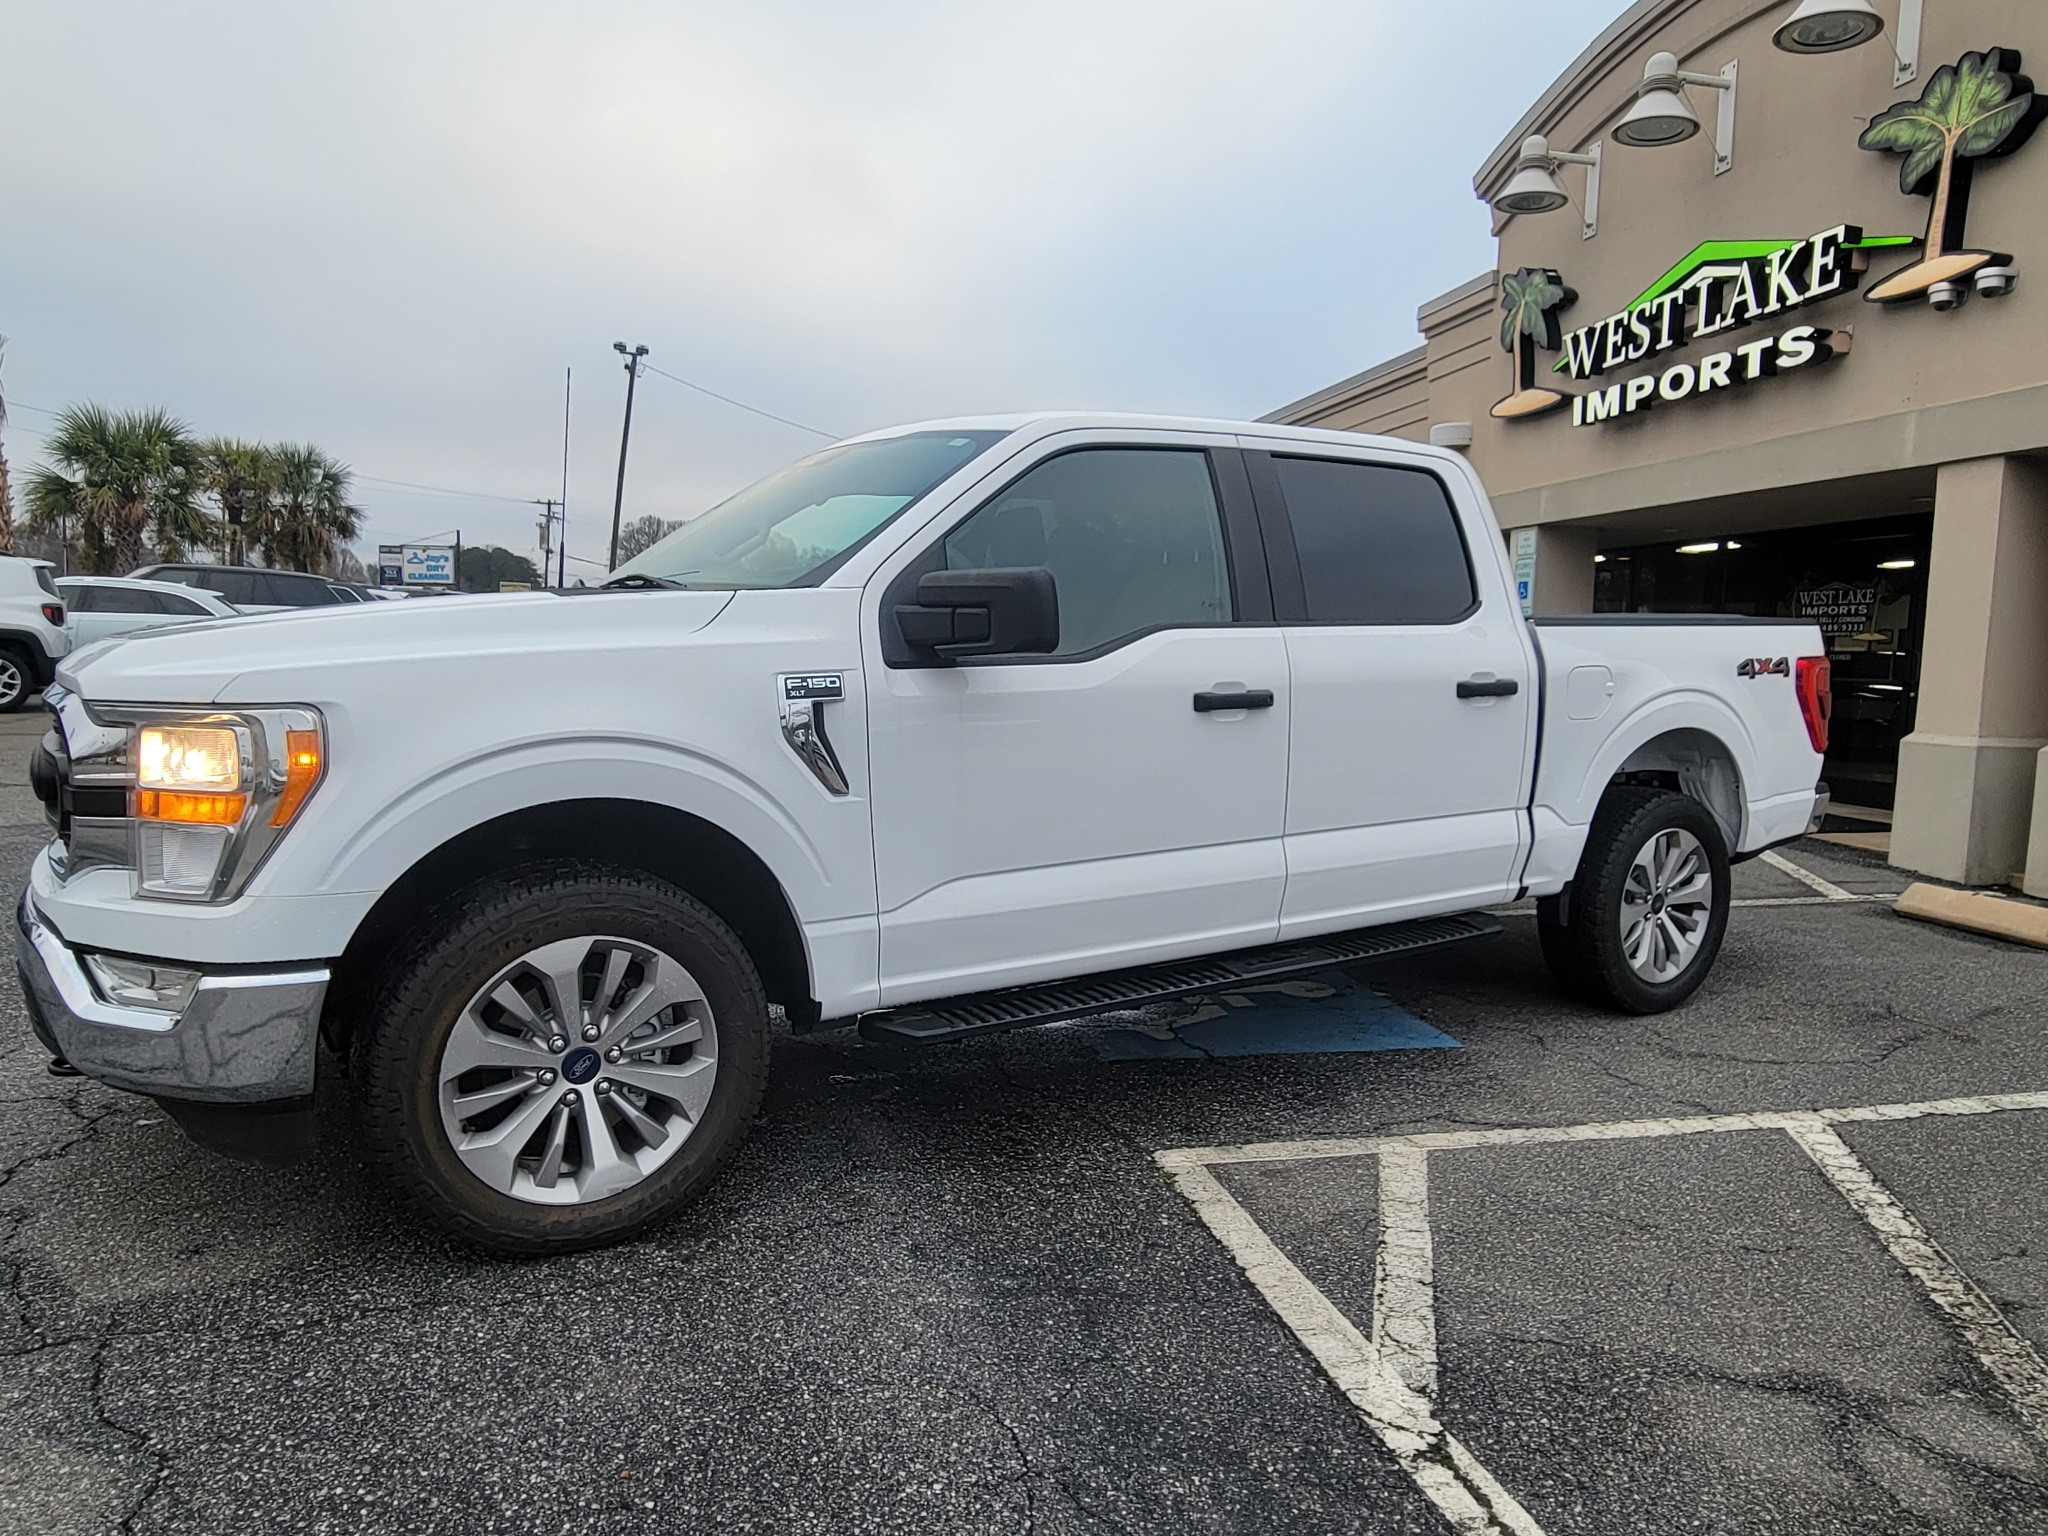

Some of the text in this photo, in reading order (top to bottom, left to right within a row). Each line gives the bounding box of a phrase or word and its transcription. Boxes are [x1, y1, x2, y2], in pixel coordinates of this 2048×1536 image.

[1562, 224, 1846, 380] WEST LAKE
[1572, 326, 1816, 427] IMPORTS
[426, 564, 446, 572] DRY
[1799, 589, 1874, 604] WEST LAKE
[1802, 605, 1868, 615] IMPORTS
[786, 677, 840, 689] F-150
